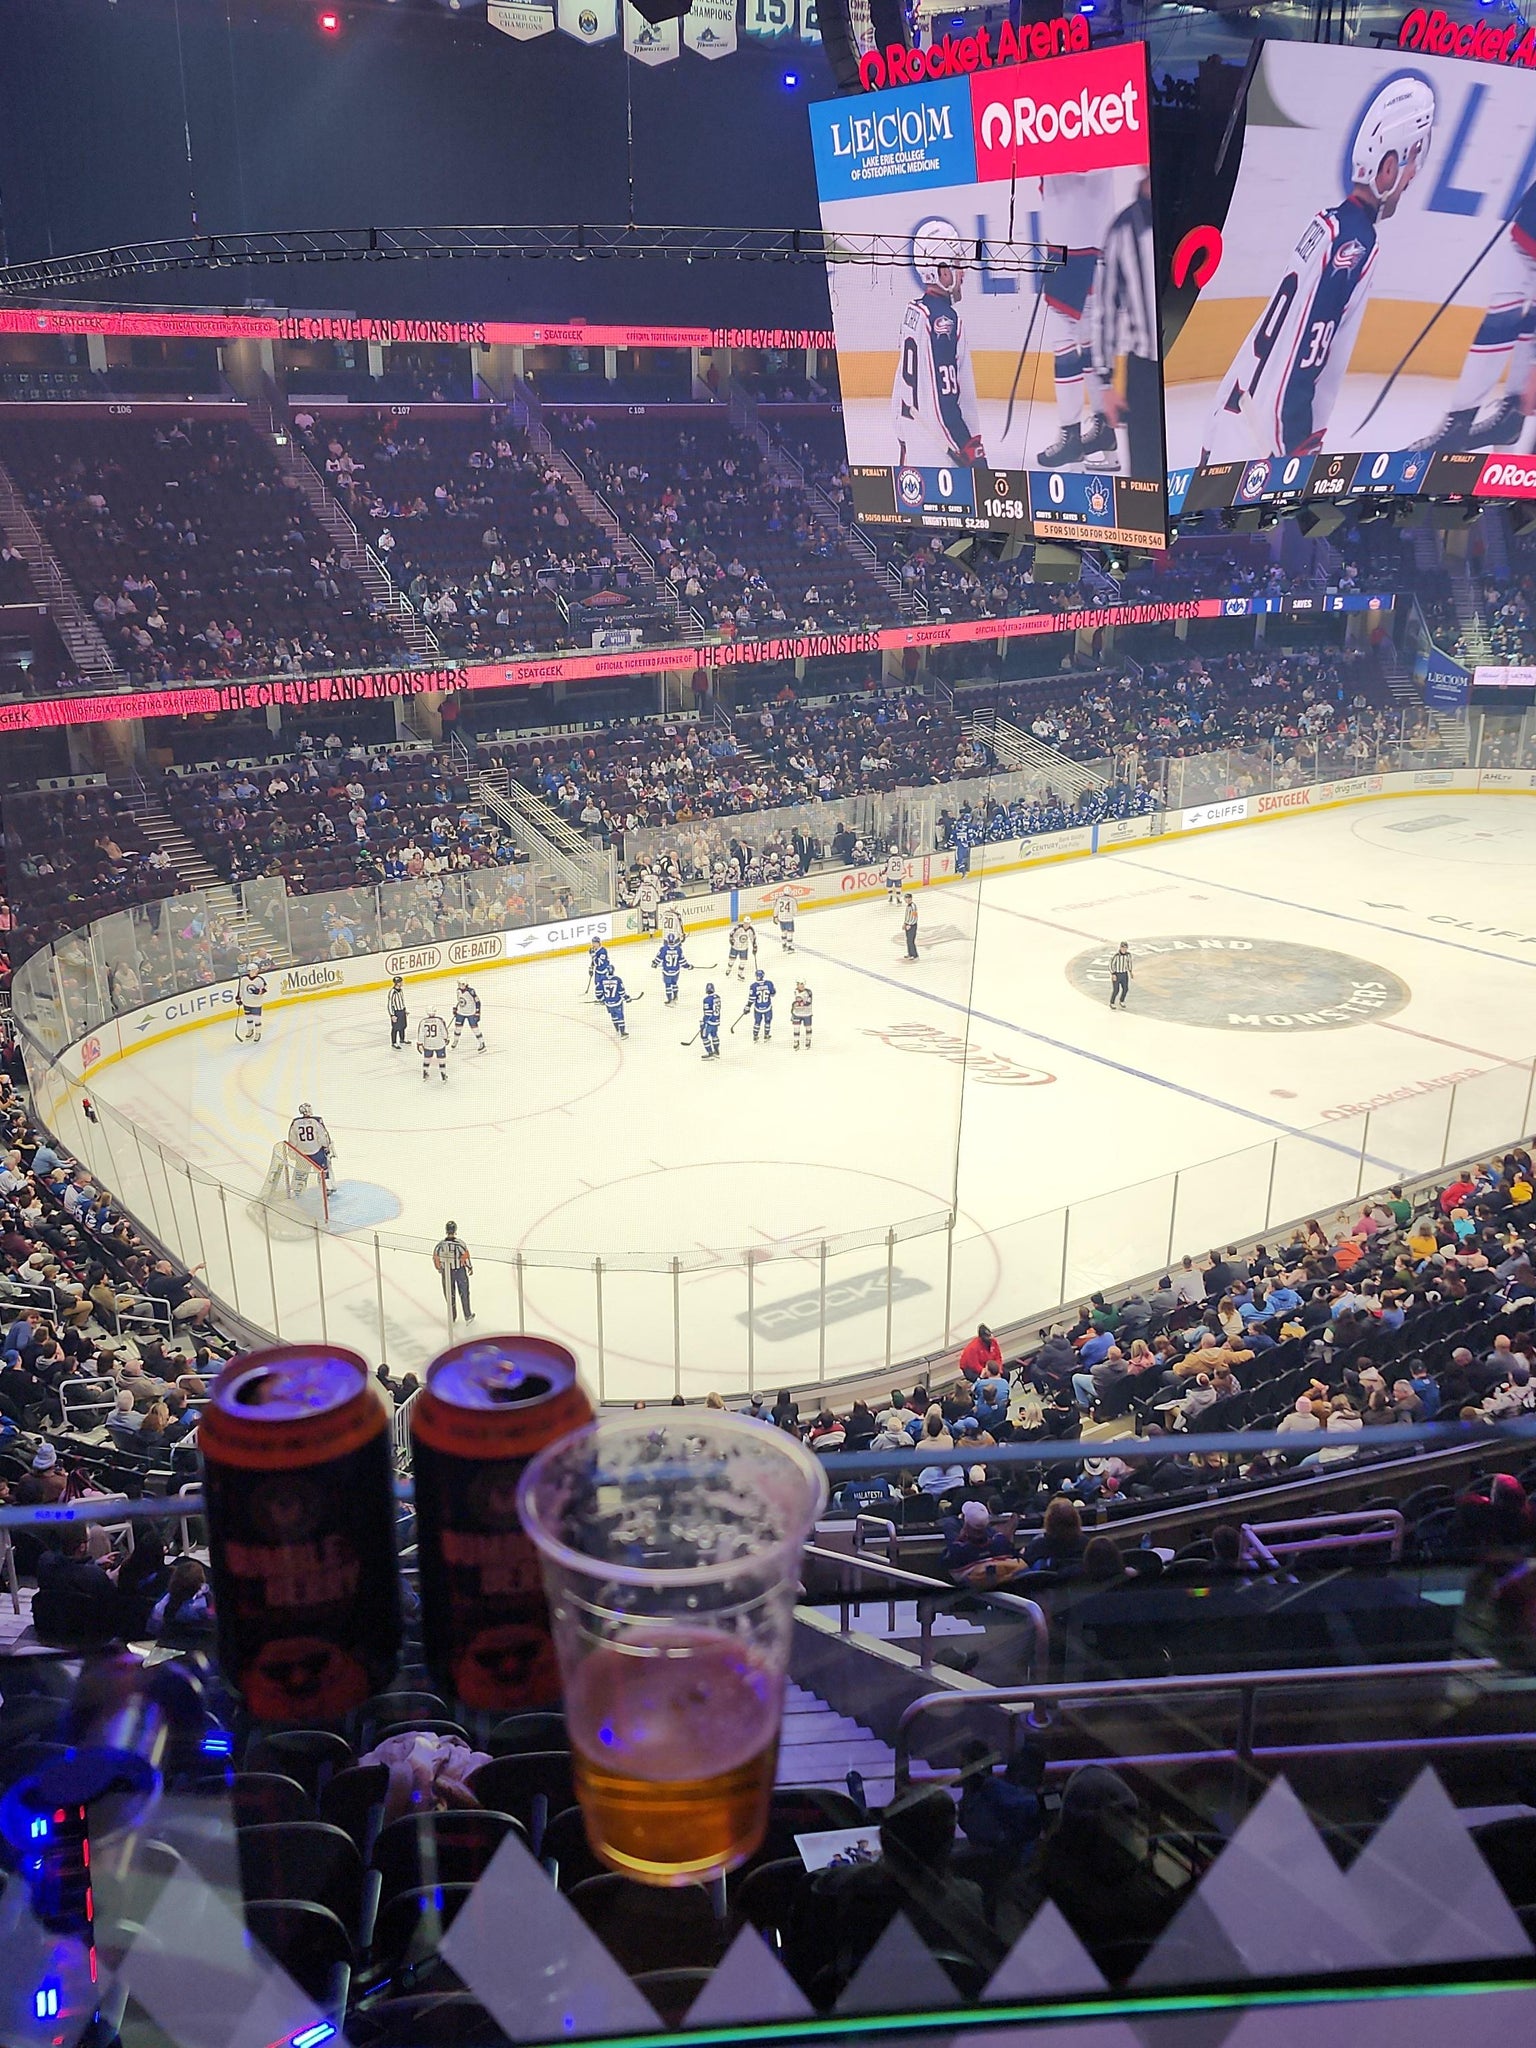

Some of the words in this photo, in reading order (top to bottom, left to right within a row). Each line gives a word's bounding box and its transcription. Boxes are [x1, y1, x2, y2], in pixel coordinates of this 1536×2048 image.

[498, 12, 527, 20] CALDER
[689, 5, 732, 21] CHAMPIONS
[755, 0, 786, 24] 15
[500, 21, 543, 30] CHAMPIONS
[1421, 10, 1517, 61] Rocket
[887, 25, 992, 87] Rocket
[997, 14, 1089, 65] Arena
[1014, 81, 1139, 146] Rocket
[862, 155, 879, 168] LAKE
[880, 154, 894, 166] ERIE
[895, 149, 925, 163] COLLEGE
[851, 169, 861, 180] OF
[862, 163, 907, 179] OSTEOPATHIC
[907, 158, 940, 173] MEDICINE
[310, 318, 399, 340] CLEVELAND
[404, 321, 485, 343] MONSTERS
[544, 330, 583, 341] SEATGEEK
[735, 329, 803, 348] CLEVELAND
[1300, 320, 1335, 369] 39
[938, 364, 957, 396] 39
[117, 406, 132, 414] 106
[400, 406, 410, 414] 107
[862, 468, 887, 477] PENALTY
[1283, 457, 1300, 485] 0
[1370, 453, 1389, 479] 0
[938, 469, 953, 497] 0
[1049, 474, 1065, 503] 0
[1130, 481, 1159, 493] PENALTY
[1313, 478, 1345, 495] 10:58
[983, 499, 1024, 519] 10:58
[882, 515, 902, 523] RAFFLE
[1044, 525, 1049, 533] 5
[1050, 526, 1062, 535] FOR
[1064, 527, 1076, 536] $10
[1080, 529, 1088, 537] 50
[1090, 529, 1102, 539] FOR
[1104, 530, 1117, 540] $20
[1121, 532, 1133, 542] 125
[1134, 534, 1147, 544] FOR
[1149, 535, 1162, 546] $40
[1266, 600, 1272, 611] 1
[1333, 597, 1343, 610] 5
[1052, 613, 1071, 632] THE
[1074, 608, 1137, 628] CLEVELAND
[1141, 601, 1200, 622] MONSTERS
[916, 628, 951, 642] SEATGEEK
[694, 646, 721, 666] THE
[724, 638, 803, 663] CLEVELAND
[809, 633, 880, 657] MONSTERS
[517, 666, 563, 680] SEATGEEK
[1428, 672, 1468, 687] LECOM
[217, 687, 251, 709] THE
[257, 677, 365, 706] CLEVELAND
[373, 668, 468, 697] MONSTERS
[78, 703, 116, 717] OFFICIAL
[1335, 784, 1350, 794] drug
[1351, 781, 1366, 790] mart
[1258, 789, 1310, 813] SEATGEEK
[1207, 804, 1244, 819] CLIFFS
[1032, 841, 1059, 852] CENTURY
[891, 861, 900, 871] 29
[642, 890, 652, 902] 26
[682, 904, 715, 916] MUTUAL
[779, 901, 790, 912] 24
[664, 917, 673, 928] 20
[547, 922, 607, 943] CLIFFS
[665, 954, 679, 967] 97
[287, 968, 335, 989] Modelo
[603, 984, 617, 998] 57
[756, 989, 770, 1003] 36
[165, 990, 234, 1020] CLIFFS
[1228, 981, 1387, 1026] MONSTERS
[424, 1024, 437, 1038] 39
[298, 1125, 314, 1141] 28
